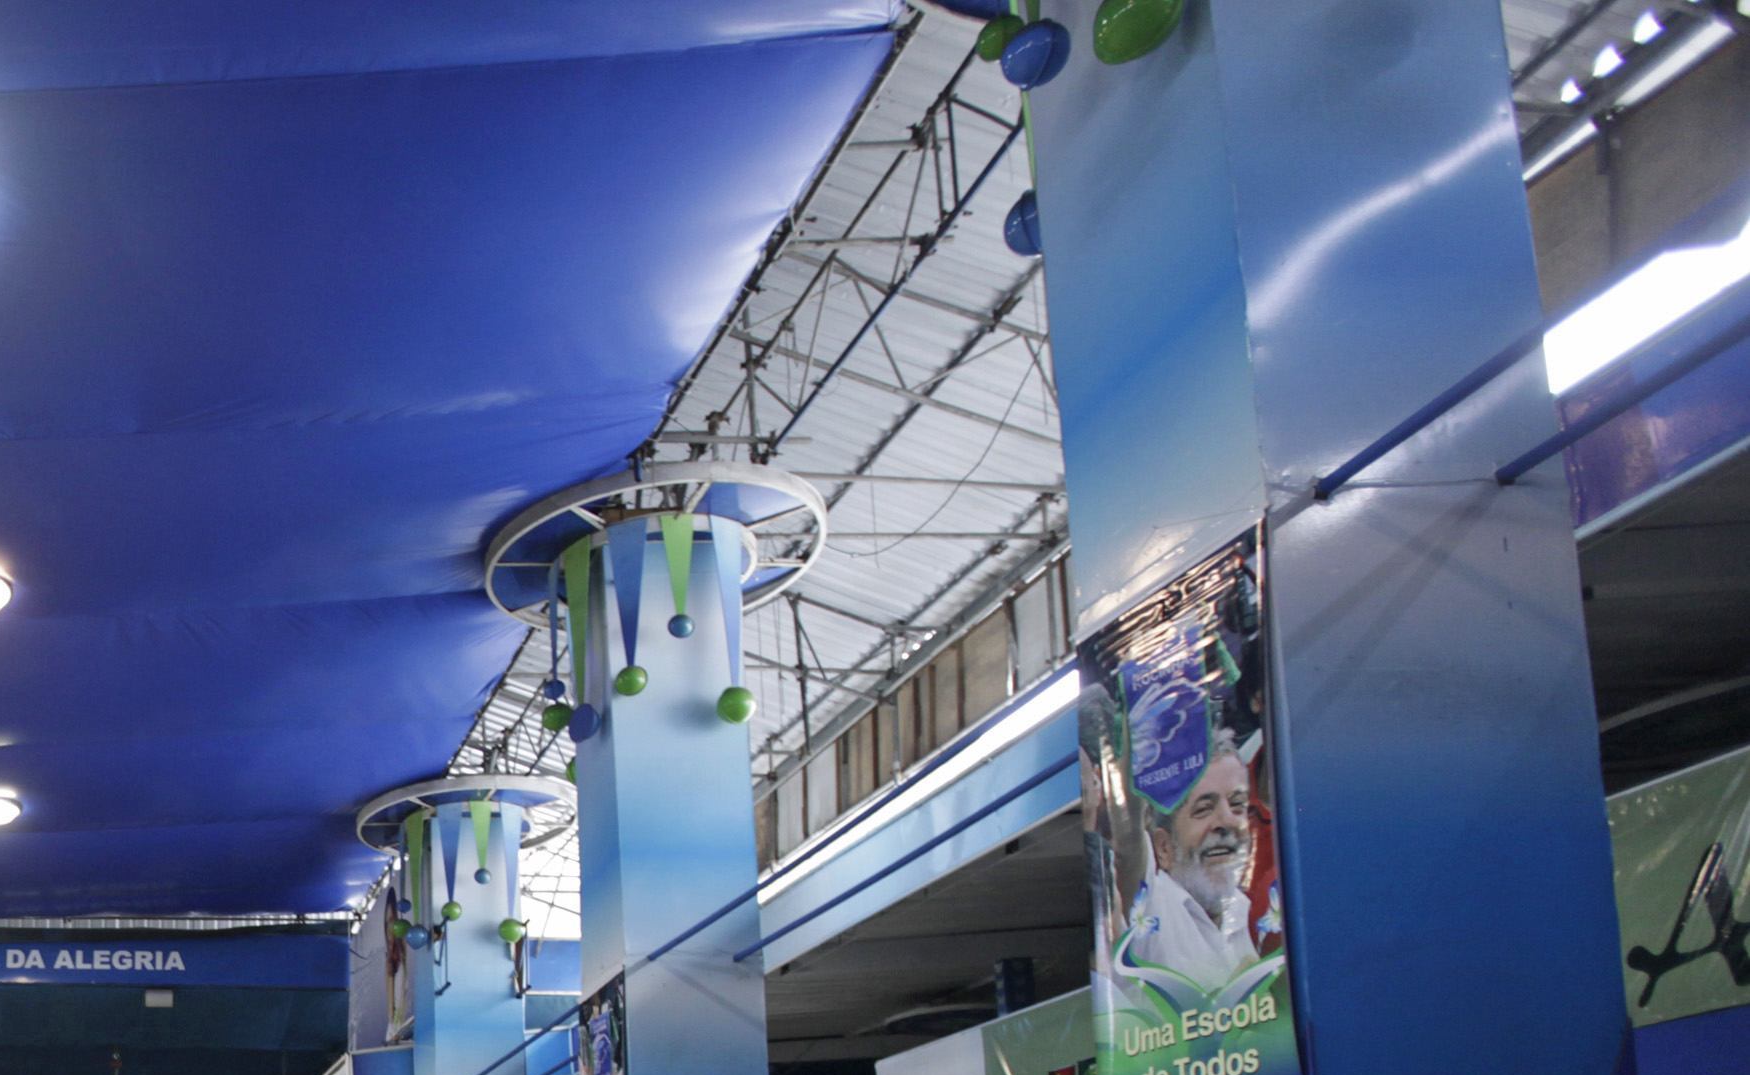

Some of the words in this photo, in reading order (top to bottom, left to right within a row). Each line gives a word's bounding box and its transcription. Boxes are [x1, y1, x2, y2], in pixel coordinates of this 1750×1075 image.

[4, 948, 46, 970] DA
[53, 949, 186, 972] ALEGRIA
[1124, 1022, 1176, 1057] Uma
[1180, 991, 1277, 1041] Escola
